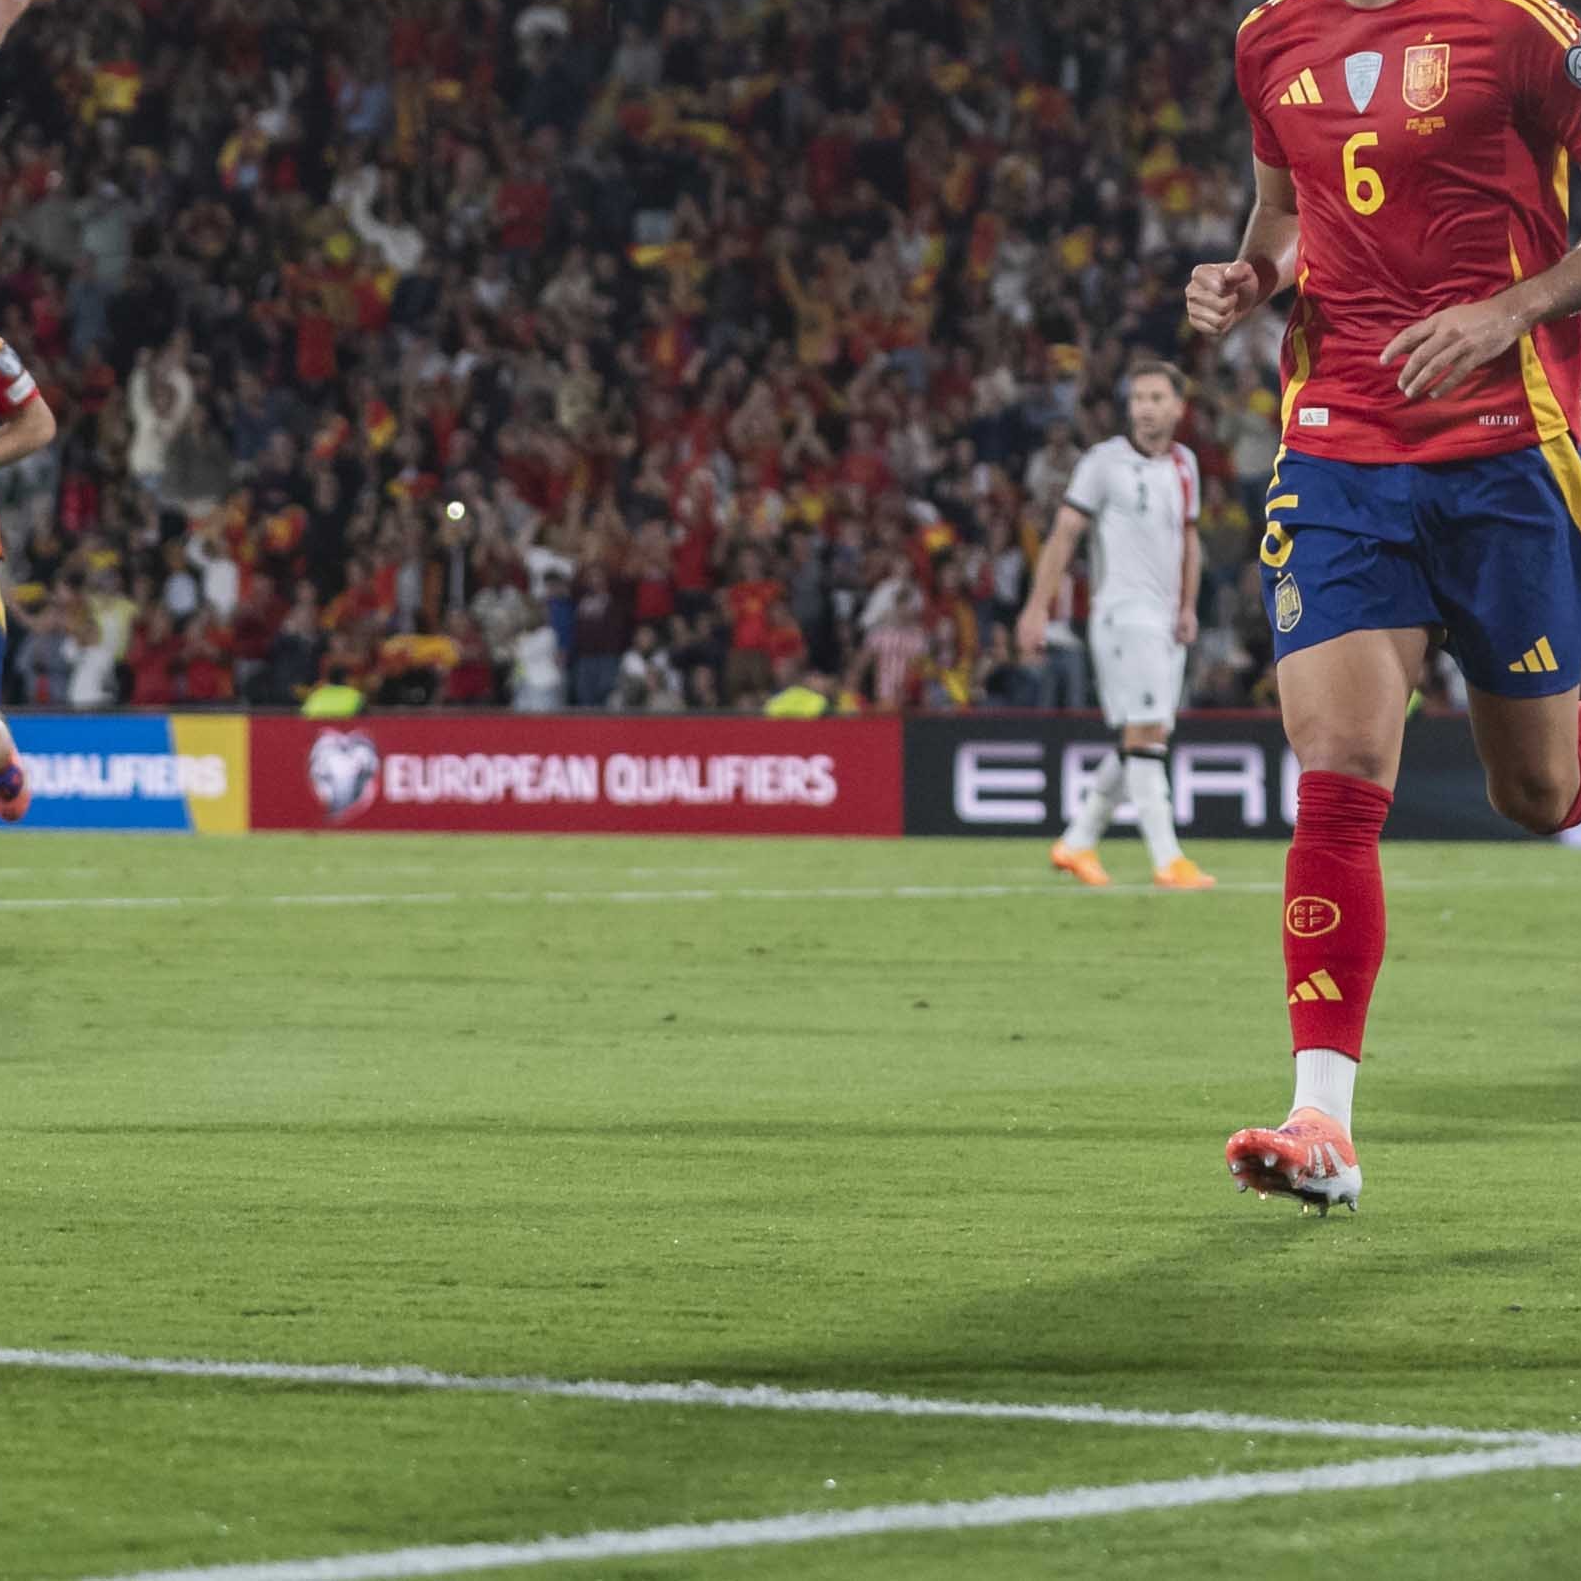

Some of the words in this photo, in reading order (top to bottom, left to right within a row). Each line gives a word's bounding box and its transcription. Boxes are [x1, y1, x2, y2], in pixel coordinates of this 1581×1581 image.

[1342, 130, 1386, 216] 6
[383, 753, 600, 803] EUROPEAN
[605, 753, 839, 806] QUALIFIERS
